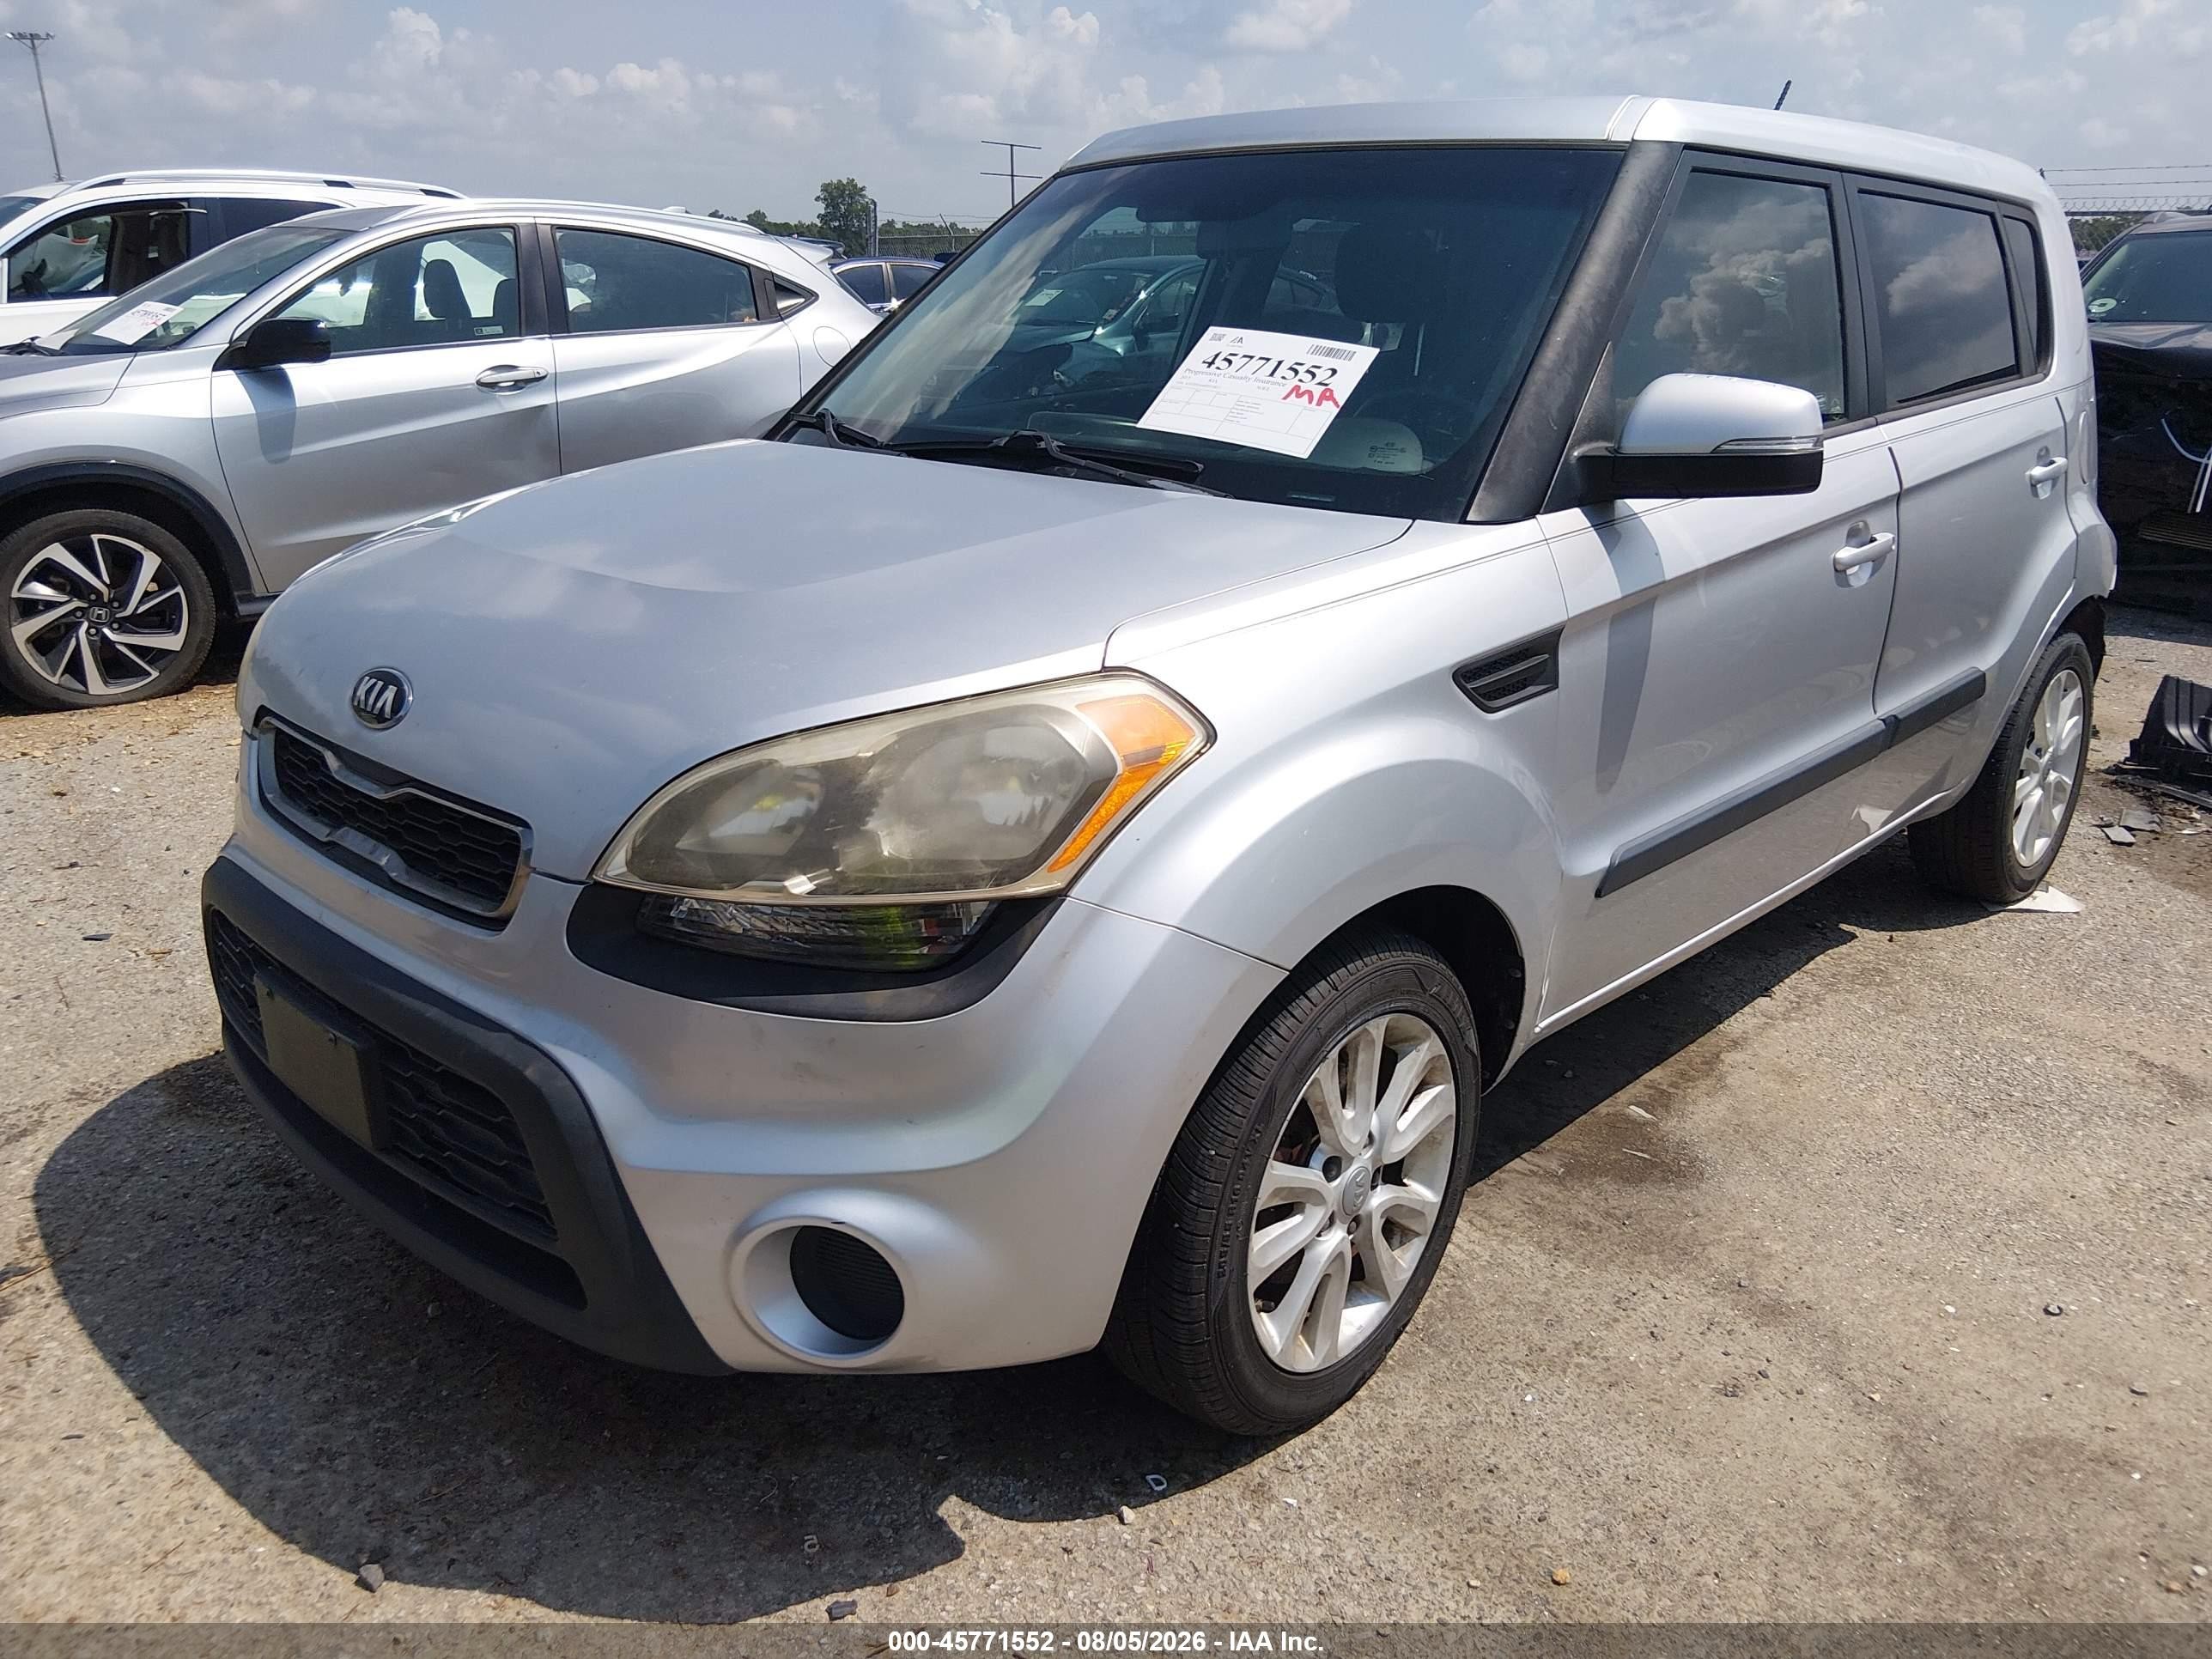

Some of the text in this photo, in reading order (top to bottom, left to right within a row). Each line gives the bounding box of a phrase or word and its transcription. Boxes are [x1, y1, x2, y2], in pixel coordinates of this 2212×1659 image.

[1184, 368, 1222, 378] Progressive
[1223, 372, 1252, 383] Casualty
[1254, 376, 1288, 387] Insurance
[1201, 350, 1338, 386] 45771552
[1281, 384, 1340, 409] MA
[354, 676, 398, 720] KIA
